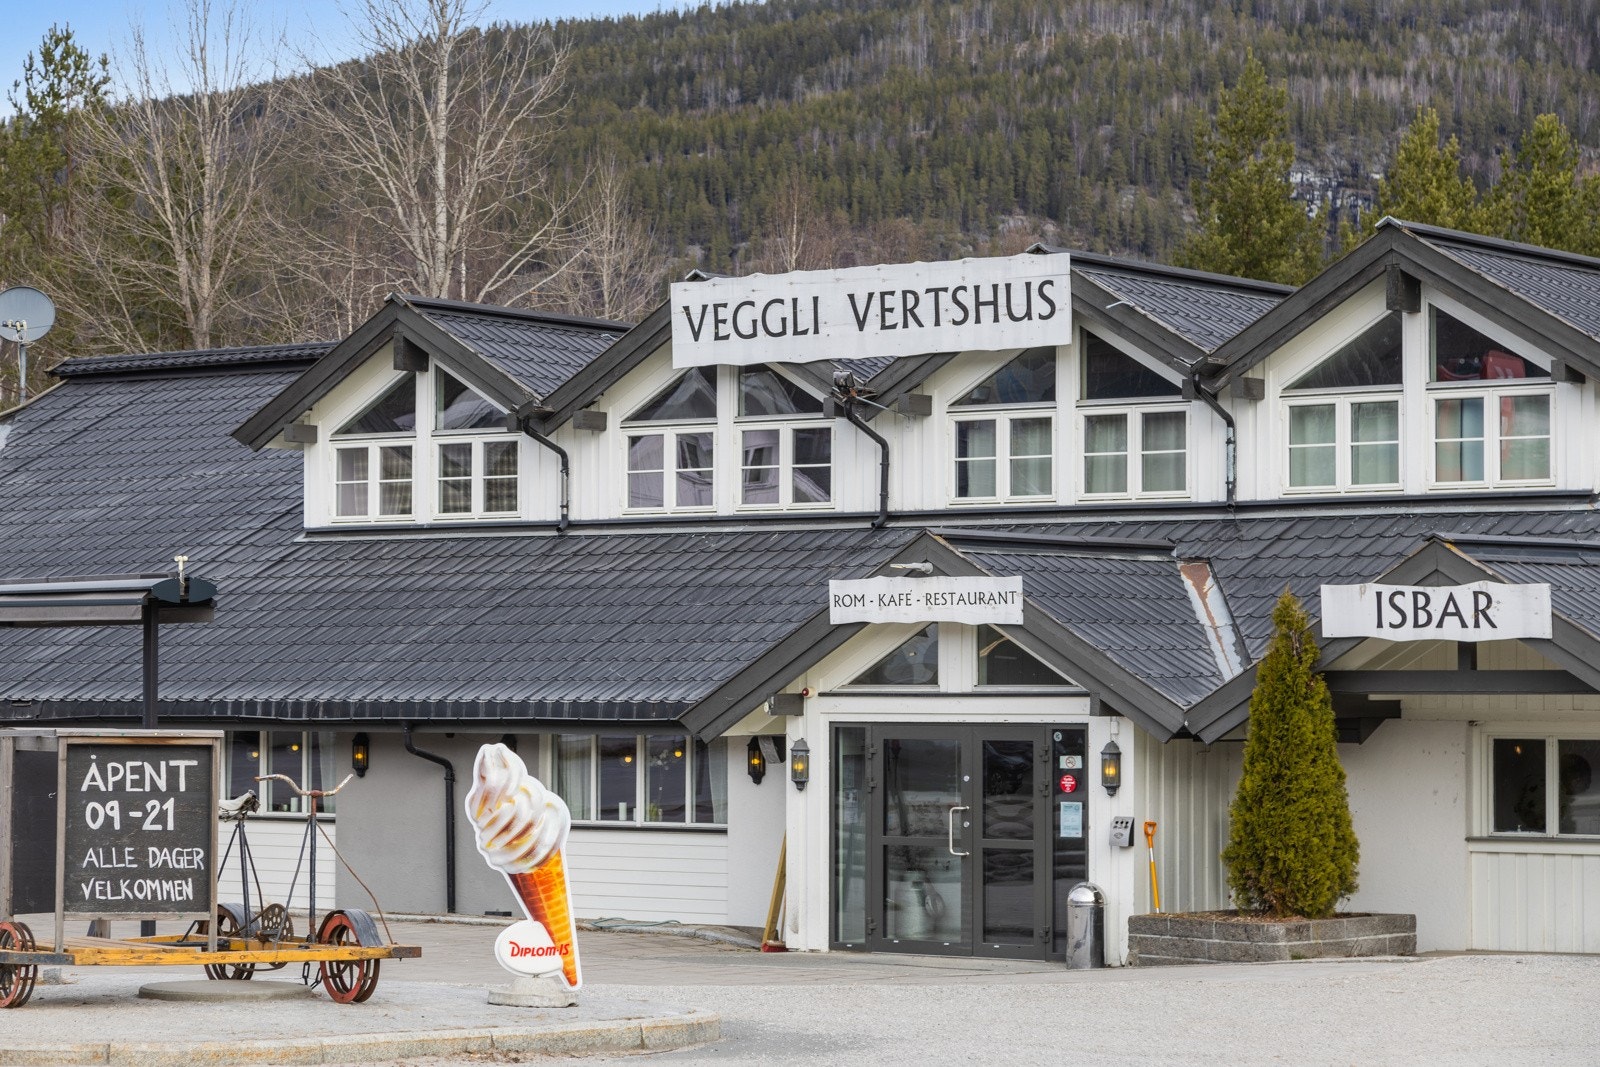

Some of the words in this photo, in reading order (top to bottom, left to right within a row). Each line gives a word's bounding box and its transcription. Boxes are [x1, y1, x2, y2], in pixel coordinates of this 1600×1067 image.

[682, 295, 820, 343] VEGGLI
[847, 279, 1056, 332] VERTSHUS
[833, 593, 866, 608] ROM
[878, 589, 912, 607] KAFÉ
[925, 590, 1017, 606] RESTAURANT
[1375, 590, 1498, 629] ISBAR
[80, 754, 199, 792] ÅPENT
[82, 847, 138, 868] ALLE
[148, 847, 205, 870] DAGER
[81, 877, 194, 901] VELKOMMEN
